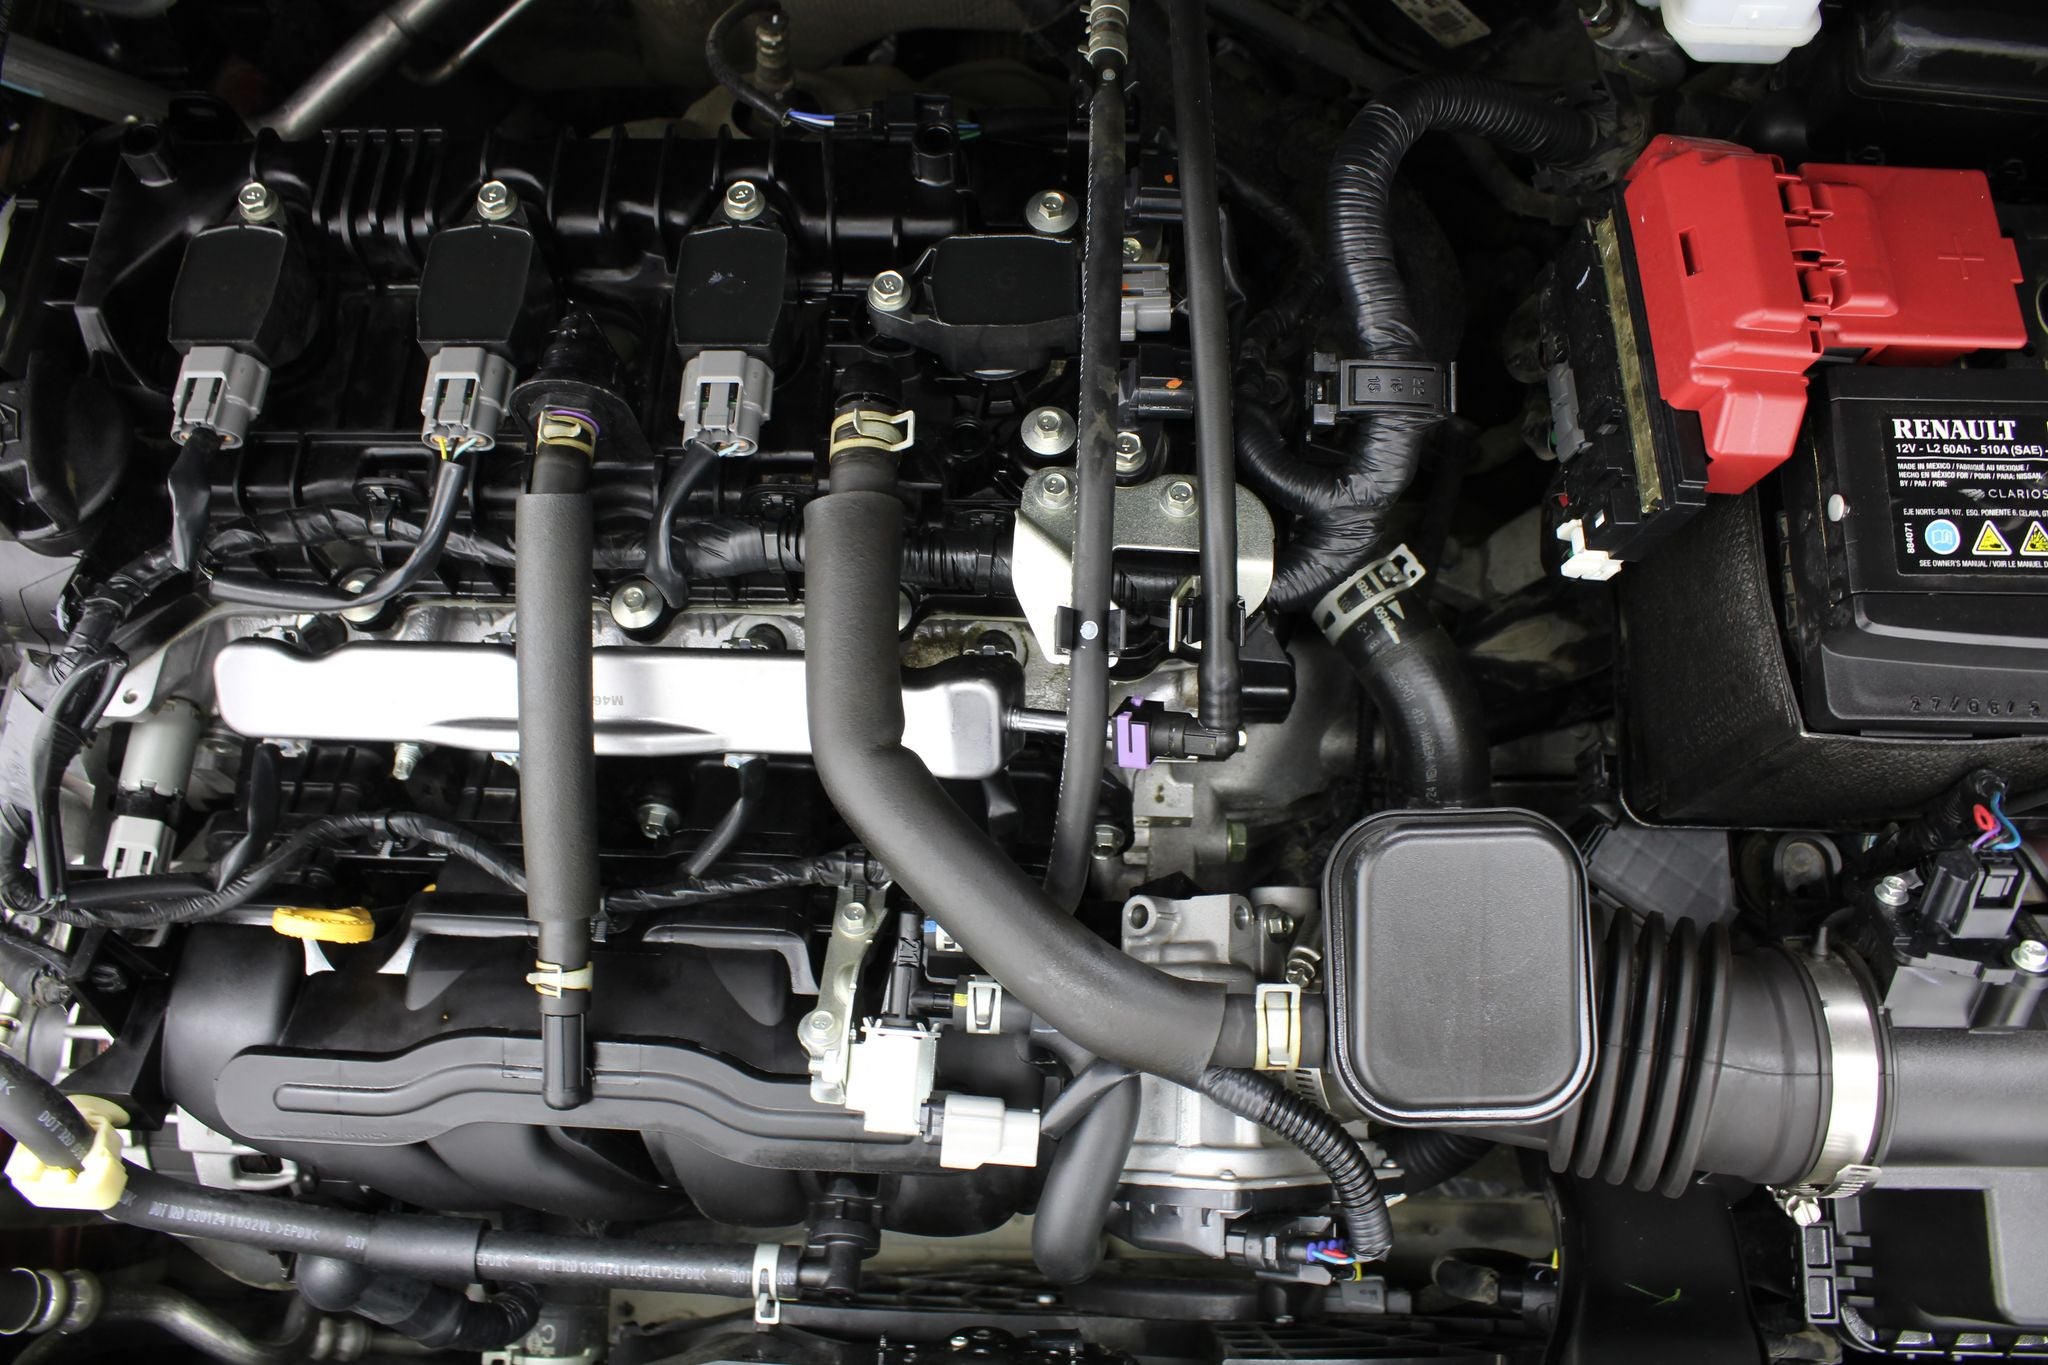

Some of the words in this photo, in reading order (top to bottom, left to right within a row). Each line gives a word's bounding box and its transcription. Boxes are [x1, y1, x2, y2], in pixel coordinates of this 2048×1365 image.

[1892, 419, 2016, 440] RENAULT
[1896, 444, 1916, 453] 12V
[1927, 444, 1940, 453] L2
[1943, 444, 1971, 454] 60Ah
[1981, 445, 2008, 455] 510A
[2011, 445, 2042, 456] (SAE)
[1956, 463, 1985, 471] FABRIQUÉ
[1931, 470, 1955, 479] MÉXICO
[1988, 489, 2048, 499] CLARIOS
[1904, 522, 1915, 554] 884071
[1993, 560, 2007, 568] VOIR
[37, 1110, 63, 1132] DOT
